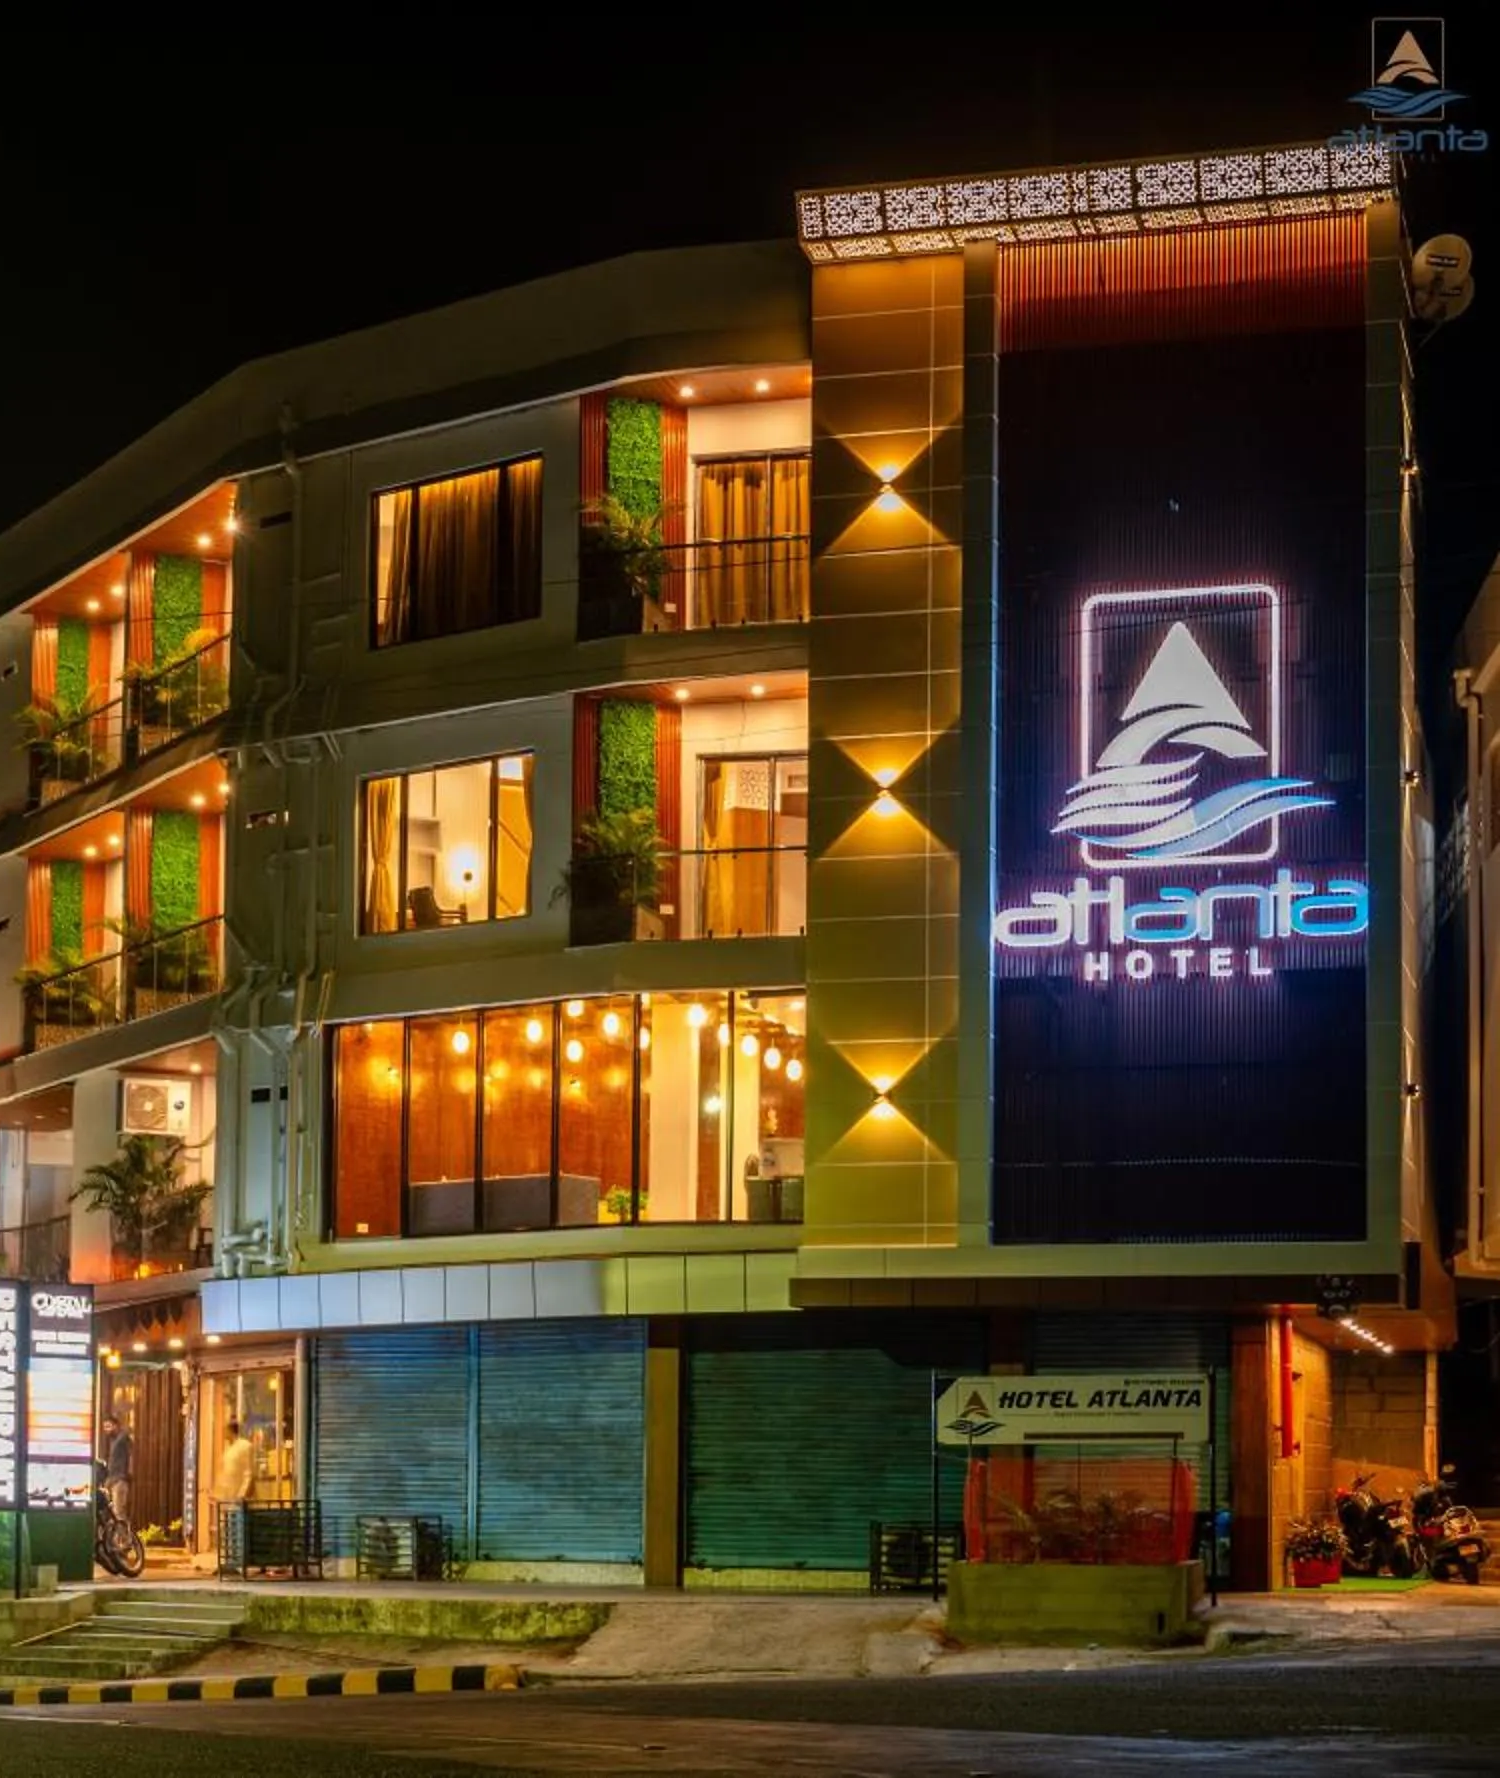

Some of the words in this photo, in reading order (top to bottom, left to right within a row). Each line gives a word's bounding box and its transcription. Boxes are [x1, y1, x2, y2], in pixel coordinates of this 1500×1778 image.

[994, 868, 1369, 947] atlanta
[1083, 947, 1273, 982] HOTEL
[999, 1390, 1079, 1410] HOTEL
[1087, 1388, 1202, 1408] ATLANTA
